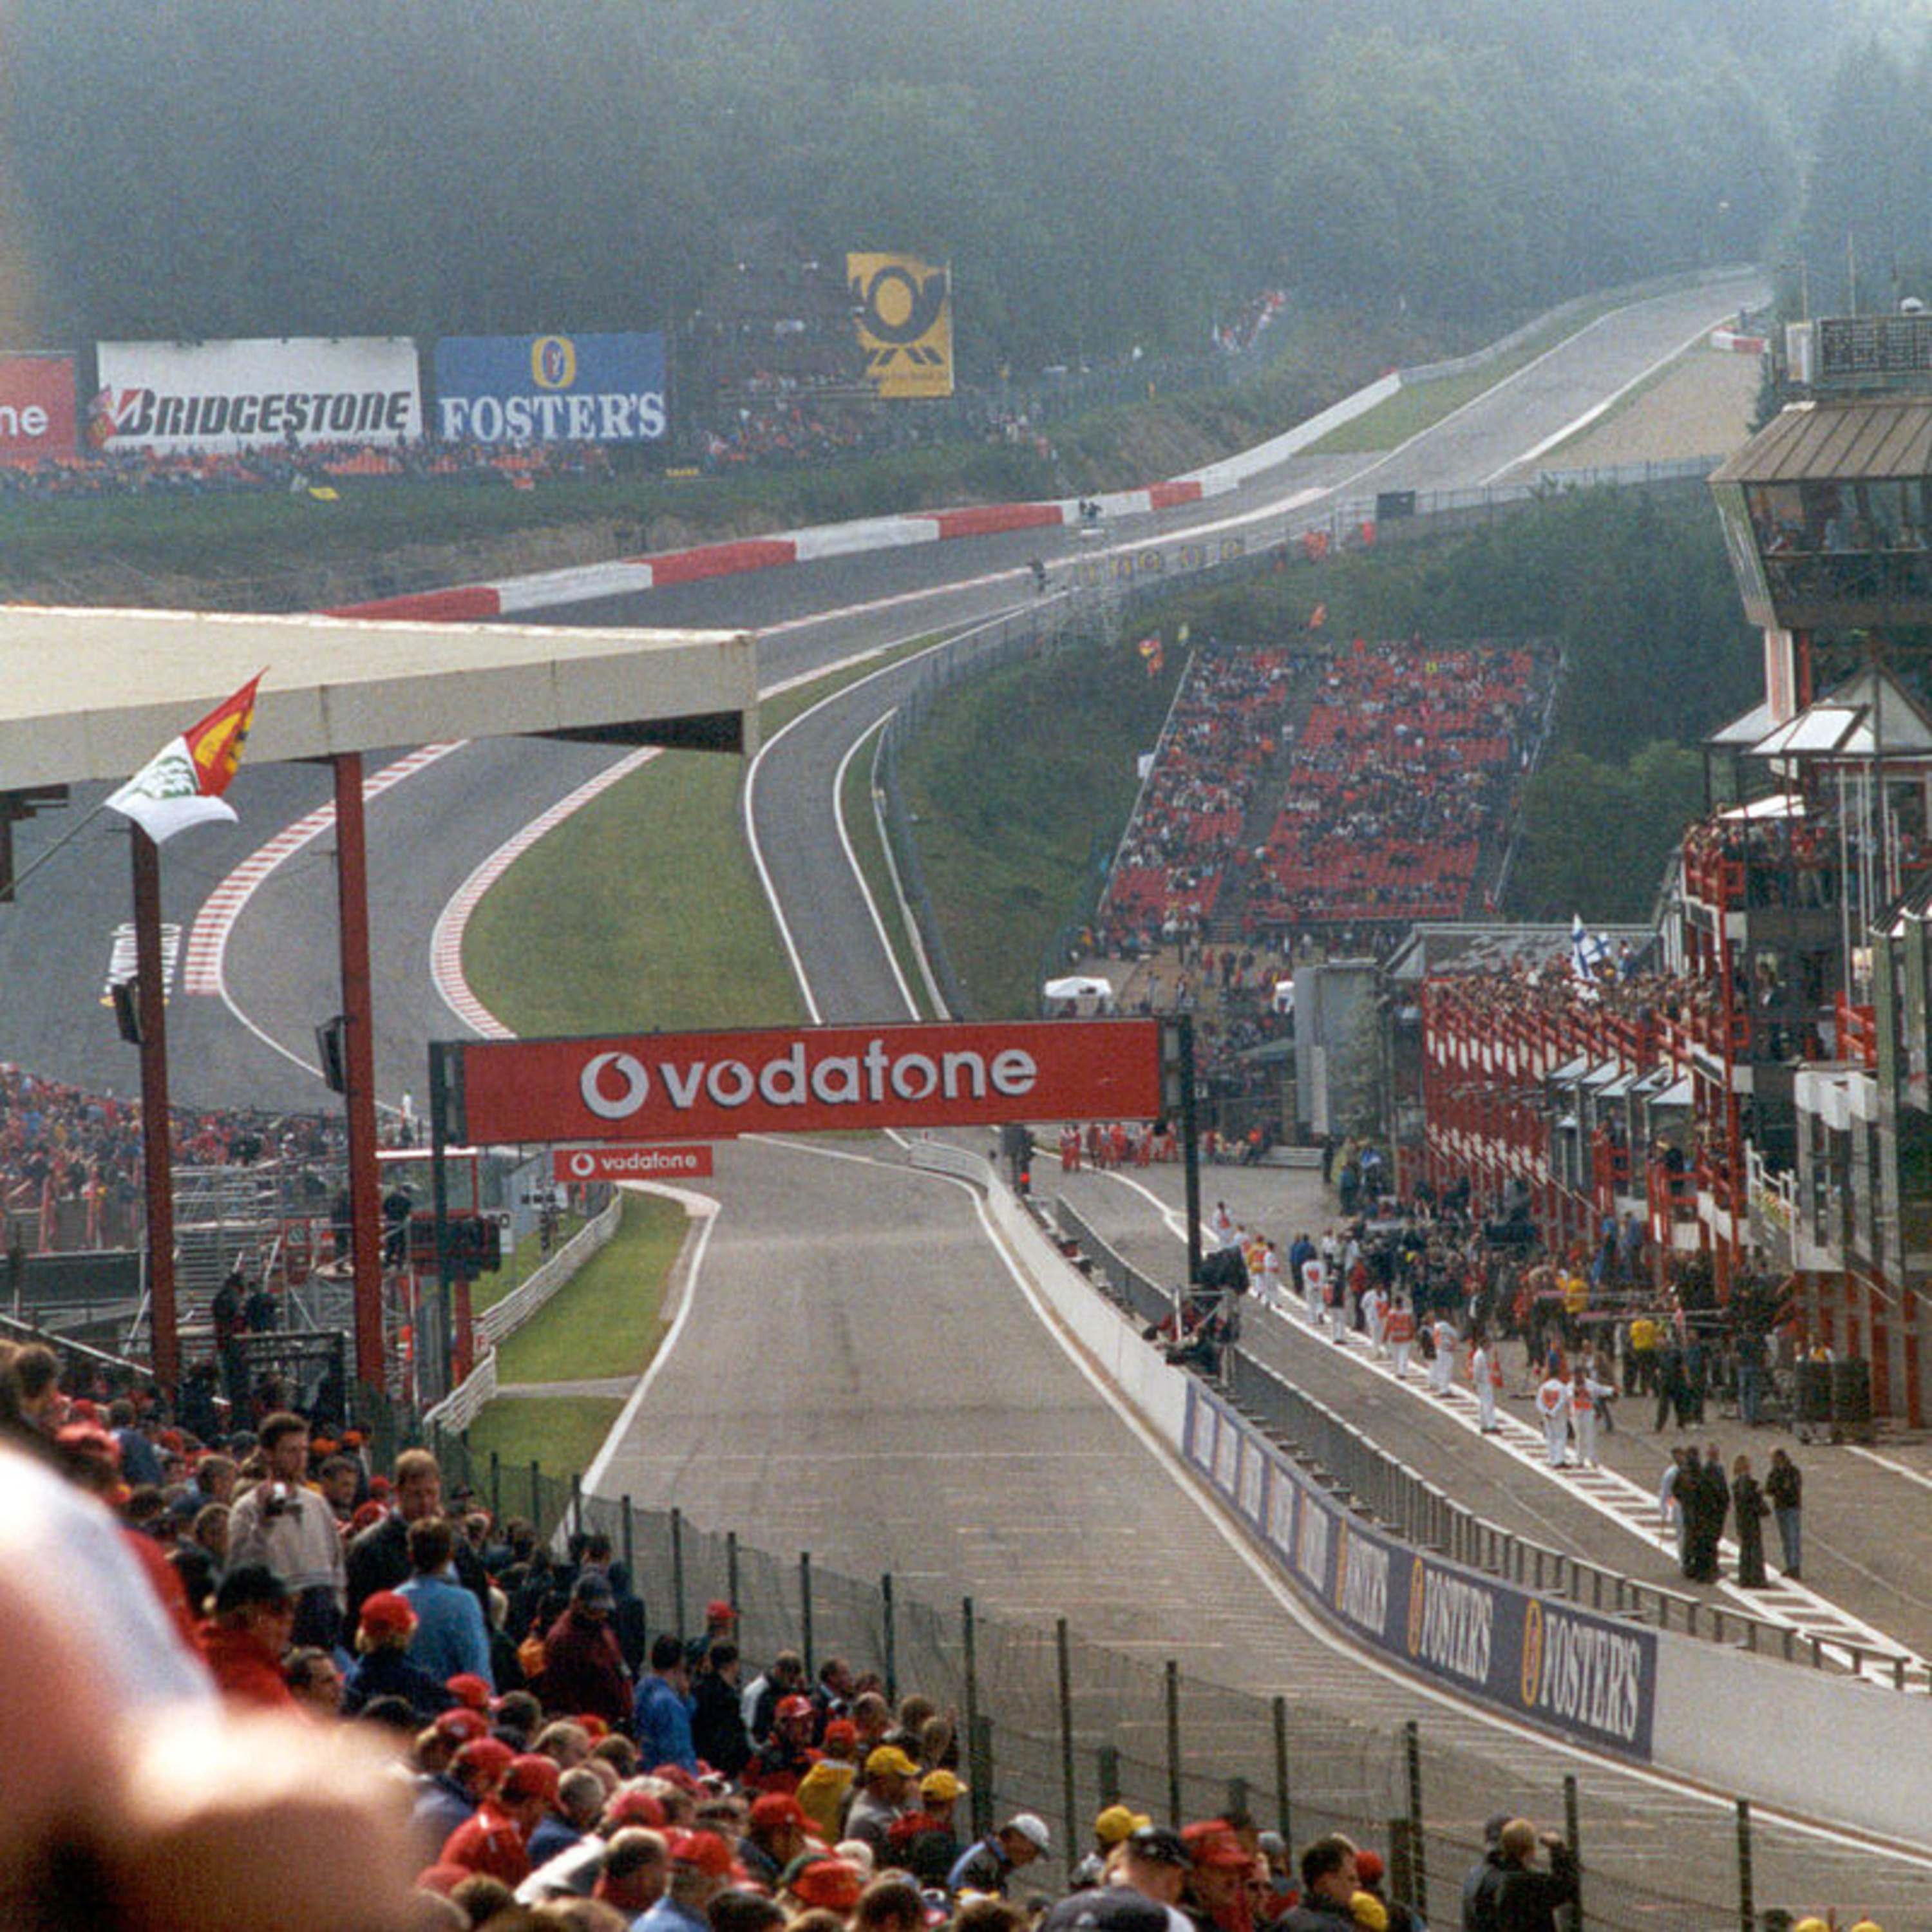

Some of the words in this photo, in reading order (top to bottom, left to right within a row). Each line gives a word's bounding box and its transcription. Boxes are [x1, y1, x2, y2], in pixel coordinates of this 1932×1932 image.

[115, 388, 411, 437] BRIDGESTONE
[439, 392, 667, 442] FOSTER'S
[658, 1039, 1038, 1109] vodafone
[601, 1151, 697, 1171] vodafone
